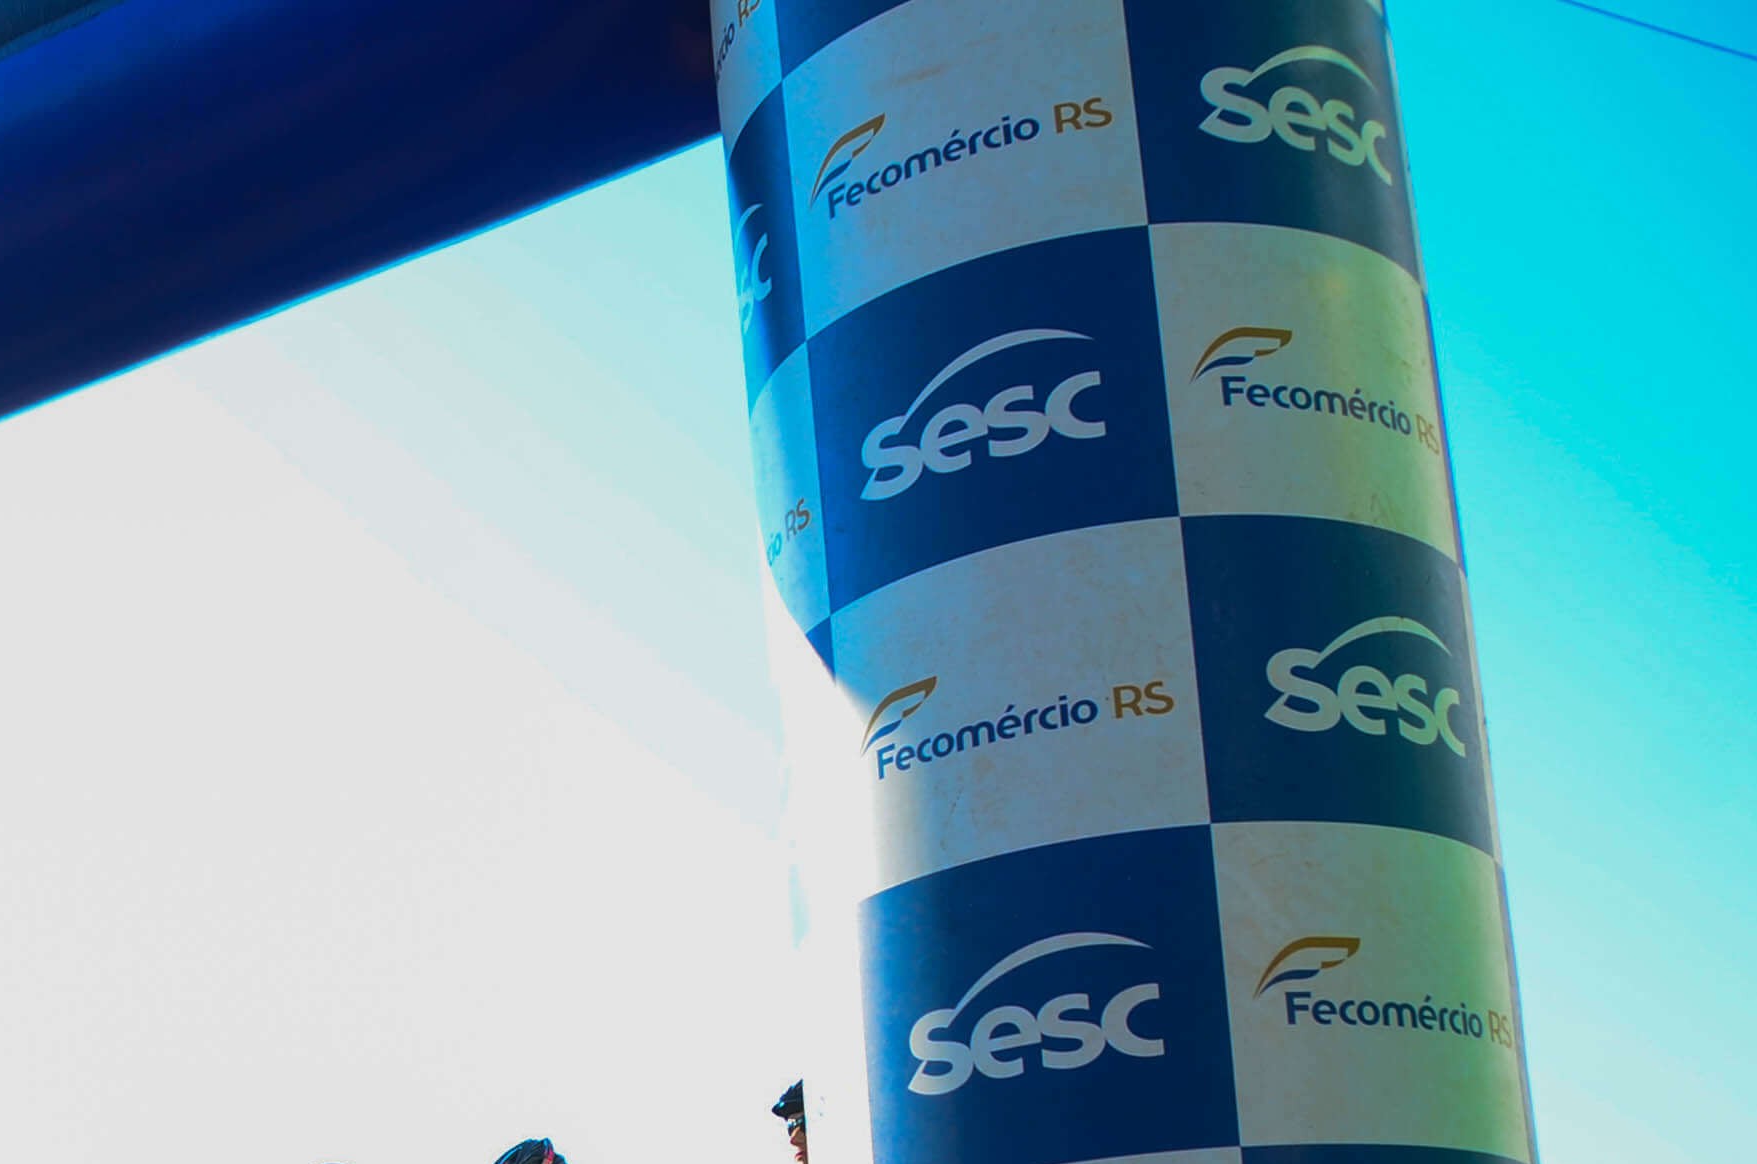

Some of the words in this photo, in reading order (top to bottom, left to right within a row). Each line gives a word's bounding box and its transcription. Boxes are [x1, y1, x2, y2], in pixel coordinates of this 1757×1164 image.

[827, 114, 1040, 219] Fecomércio
[1053, 97, 1114, 134] RS
[1220, 375, 1412, 436] Fecomércio
[785, 498, 811, 541] RS
[876, 694, 1099, 780] Fecomércio
[1111, 680, 1175, 720] RS
[1284, 991, 1483, 1039] Fecomércio
[1489, 1009, 1513, 1049] RS
